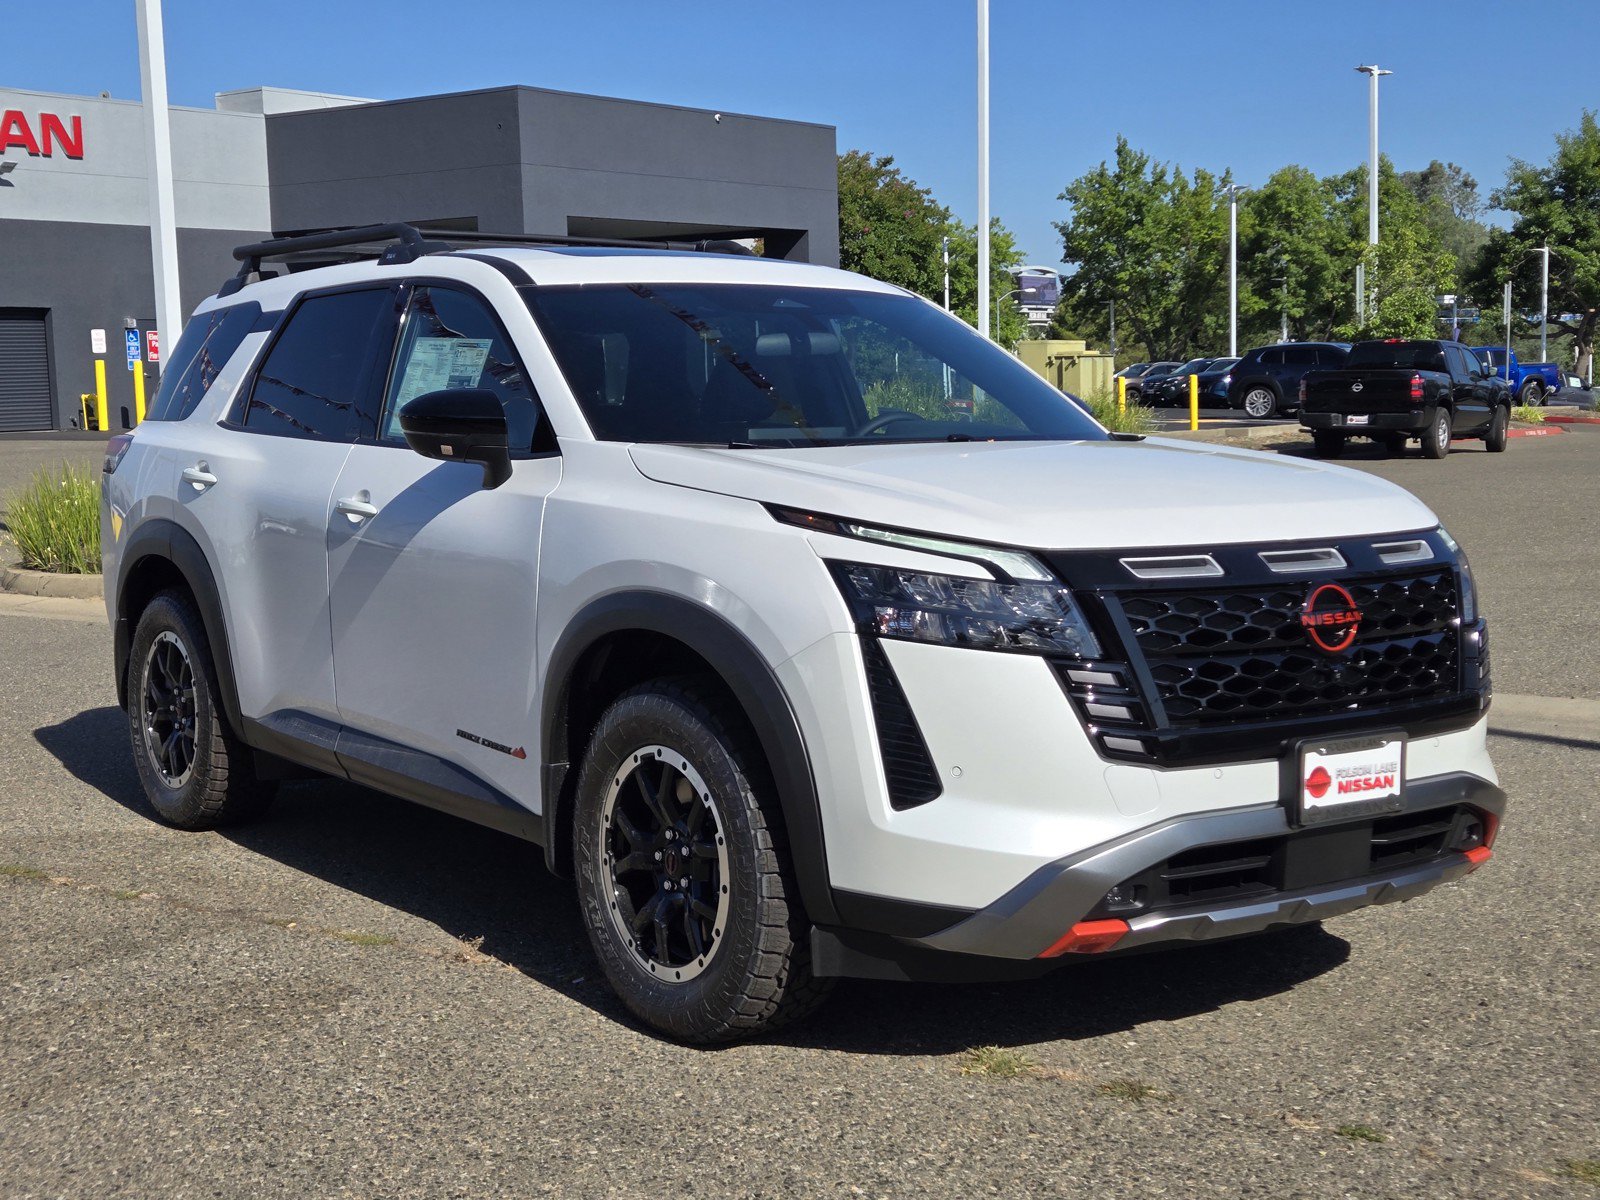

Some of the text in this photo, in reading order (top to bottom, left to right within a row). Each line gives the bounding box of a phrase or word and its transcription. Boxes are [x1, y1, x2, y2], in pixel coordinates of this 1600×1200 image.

[1301, 611, 1362, 626] NISSAN
[1335, 761, 1397, 779] FOLSOM LAKE
[1337, 774, 1395, 794] NISSAN
